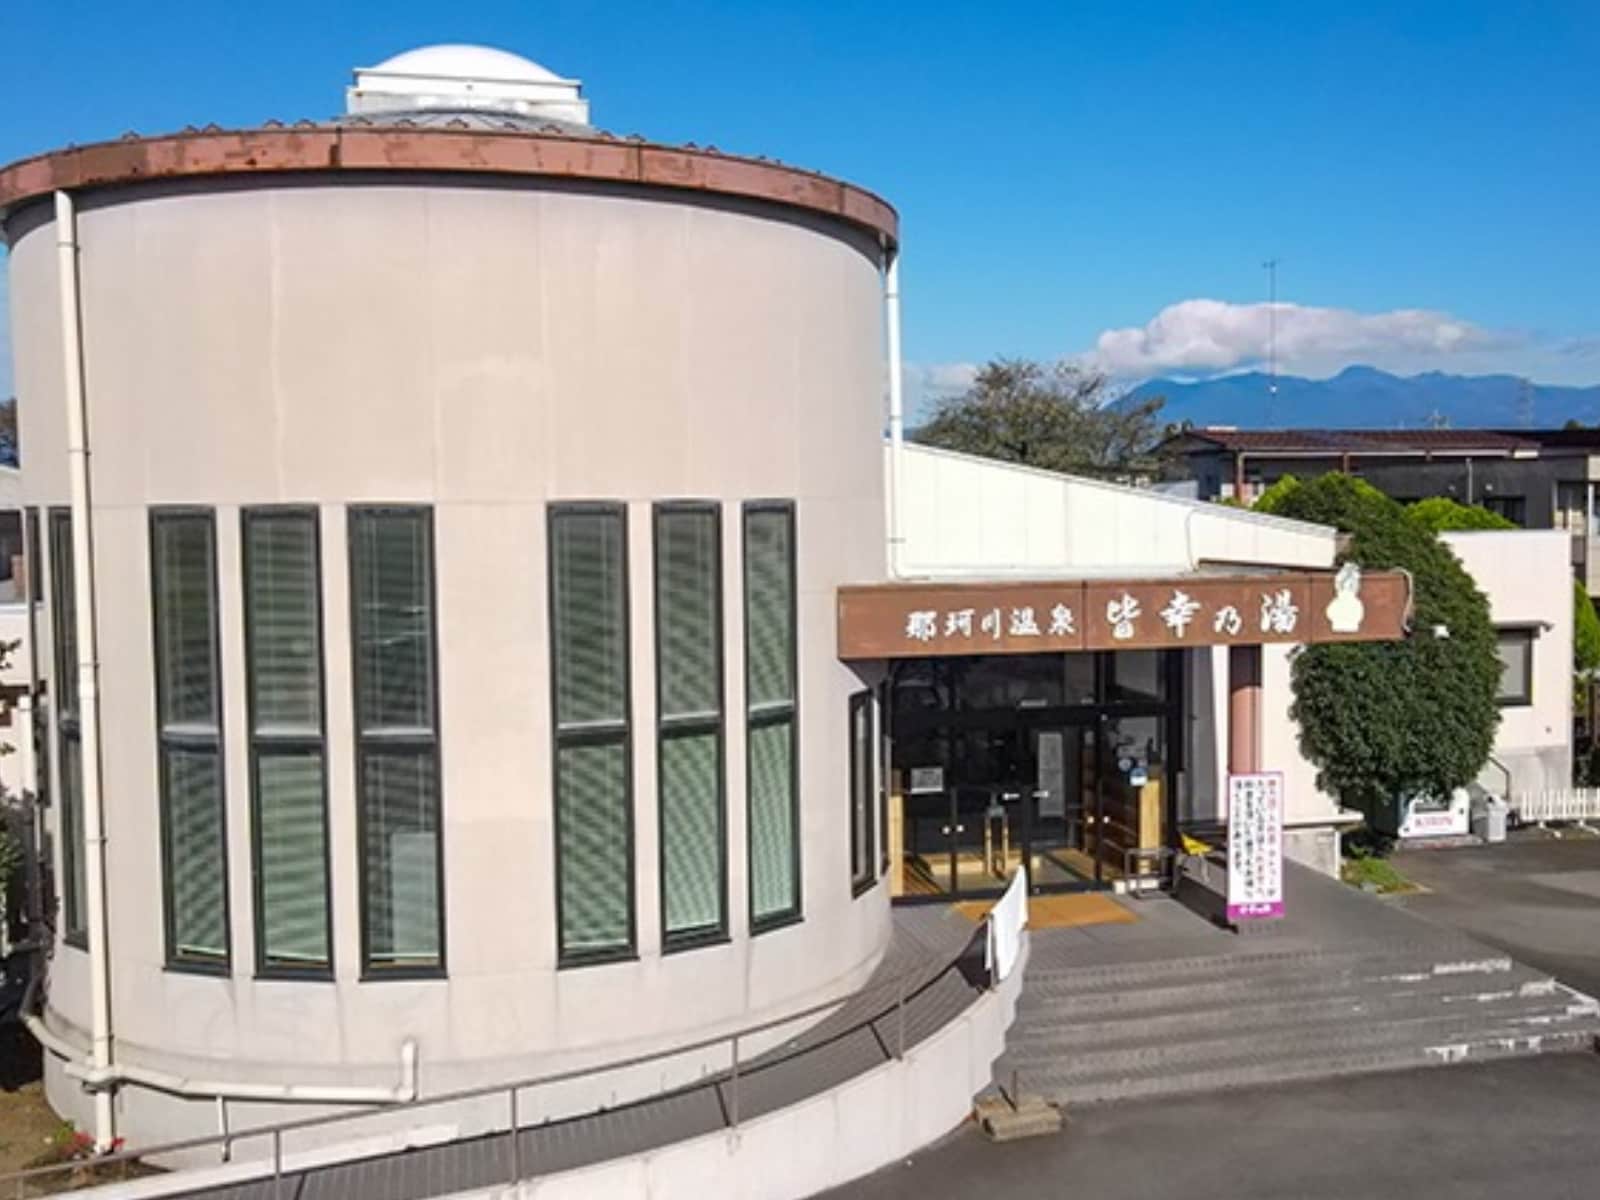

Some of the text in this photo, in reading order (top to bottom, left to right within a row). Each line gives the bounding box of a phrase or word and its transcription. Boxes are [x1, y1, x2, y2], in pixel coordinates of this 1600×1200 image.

[906, 588, 1299, 641] 那珂川温泉 皆幸乃湯
